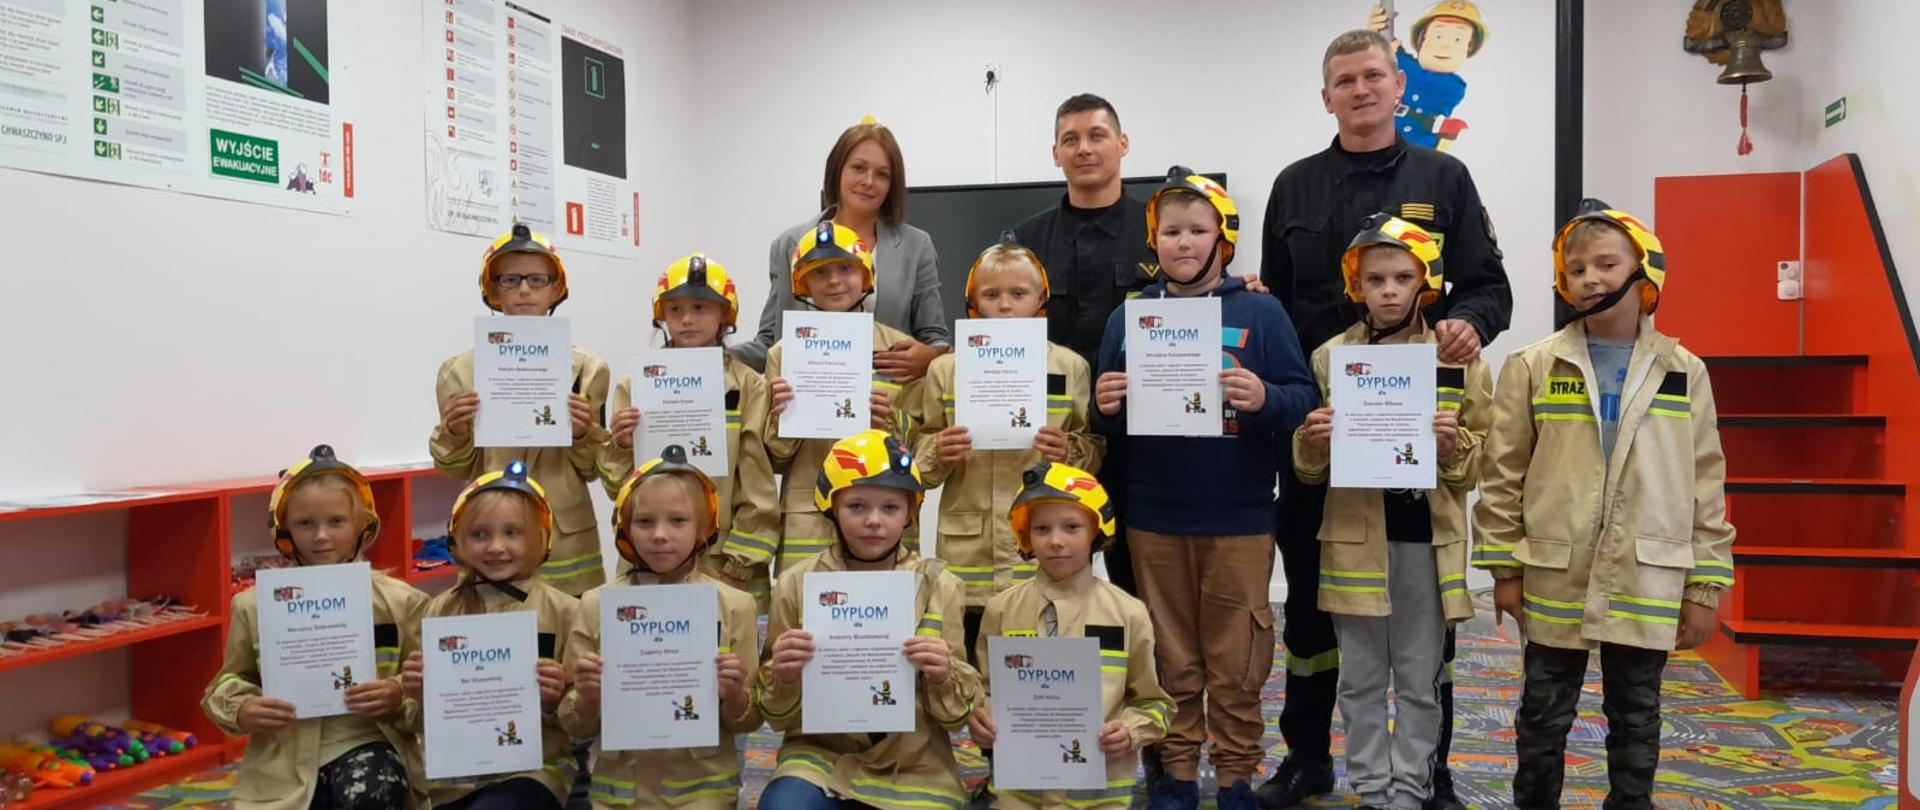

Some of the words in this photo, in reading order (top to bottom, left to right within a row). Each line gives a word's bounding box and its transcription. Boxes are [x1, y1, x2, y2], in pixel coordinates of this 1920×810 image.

[215, 137, 274, 161] WYJŚCIE
[212, 156, 278, 177] EWAKUACYJNE
[1149, 328, 1199, 340] DYPLOM
[499, 344, 549, 355] DYPLOM
[805, 339, 852, 350] DYPLOM
[978, 346, 1025, 358] DYPLOM
[654, 376, 702, 388] DYPLOM
[1357, 376, 1411, 388] DYPLOM
[287, 596, 346, 613] DYPLOM
[830, 606, 888, 619] DYPLOM
[630, 620, 690, 634] DYPLOM
[451, 648, 511, 664] DYPLOM
[1017, 669, 1075, 681] DYPLOM
